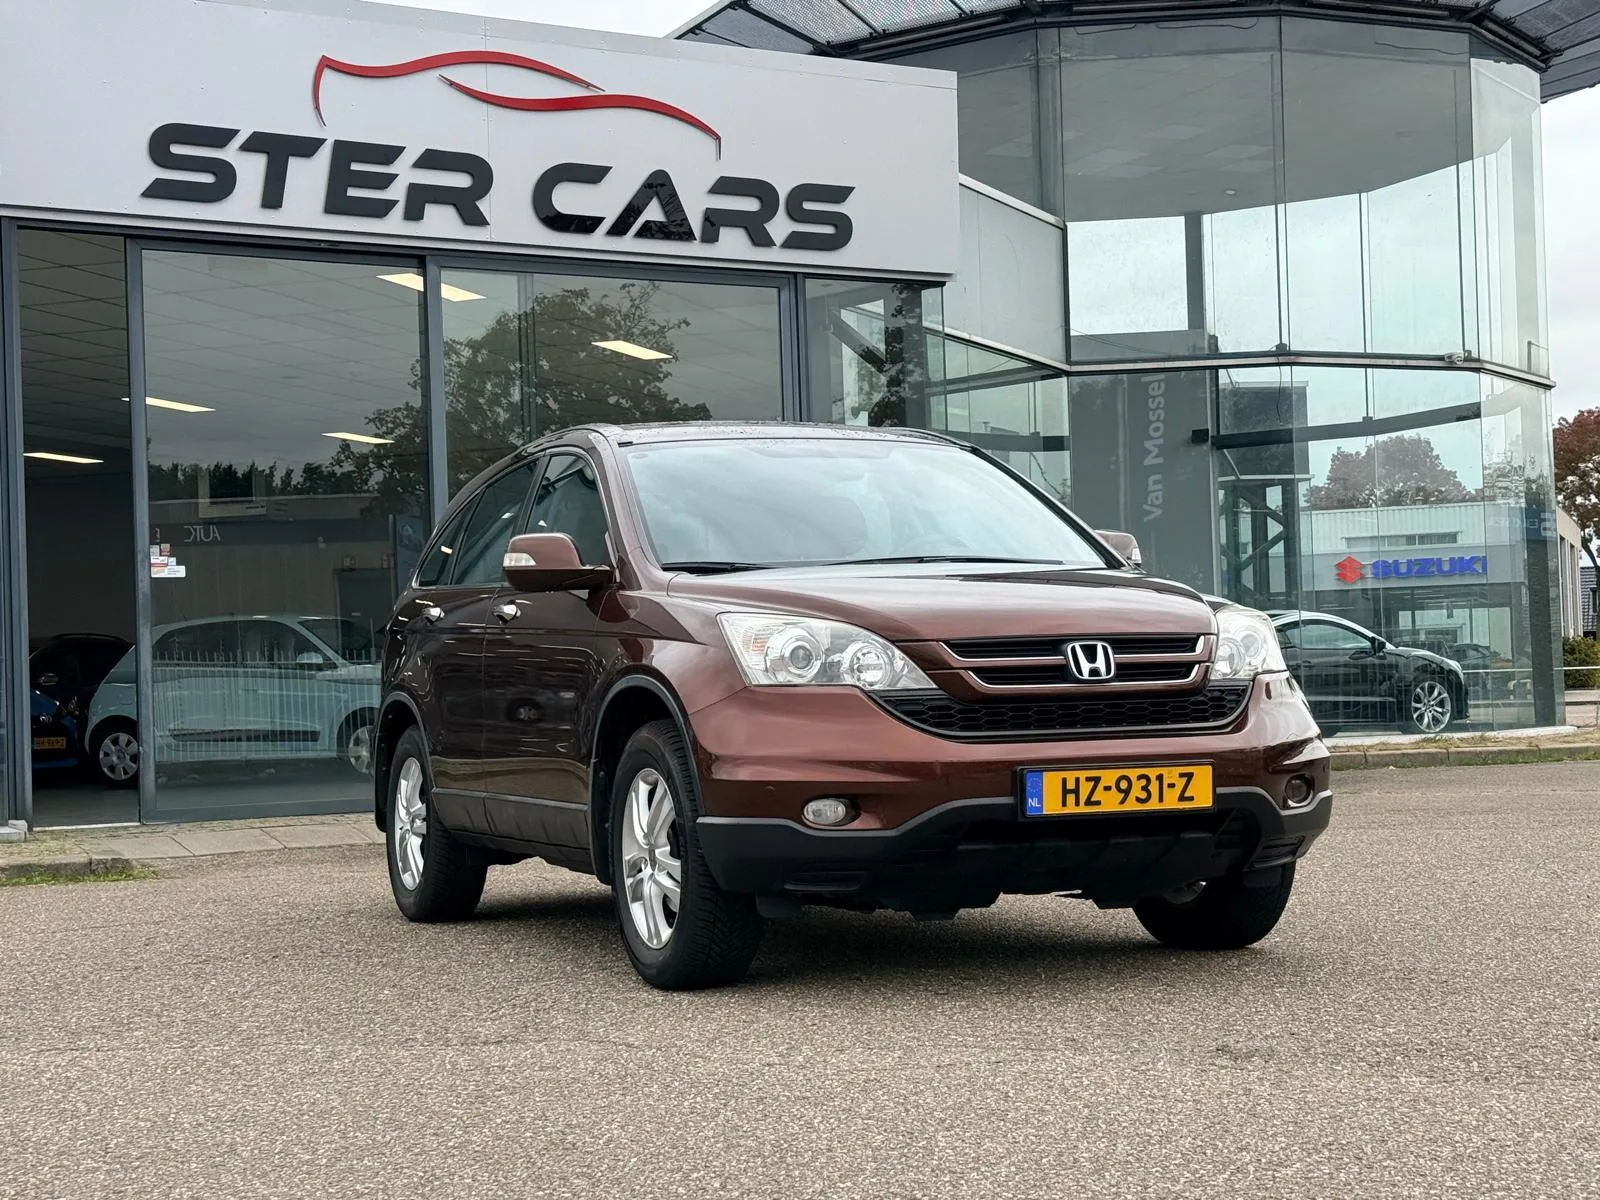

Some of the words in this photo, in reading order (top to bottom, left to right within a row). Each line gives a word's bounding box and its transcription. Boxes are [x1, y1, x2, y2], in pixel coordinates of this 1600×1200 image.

[141, 122, 494, 226] STER
[532, 162, 856, 251] CARS
[1141, 372, 1166, 466] Mossel
[1142, 473, 1163, 523] Van
[1371, 556, 1487, 577] SUZUKI
[1028, 798, 1041, 807] NL
[1061, 772, 1195, 807] HZ-931-Z
